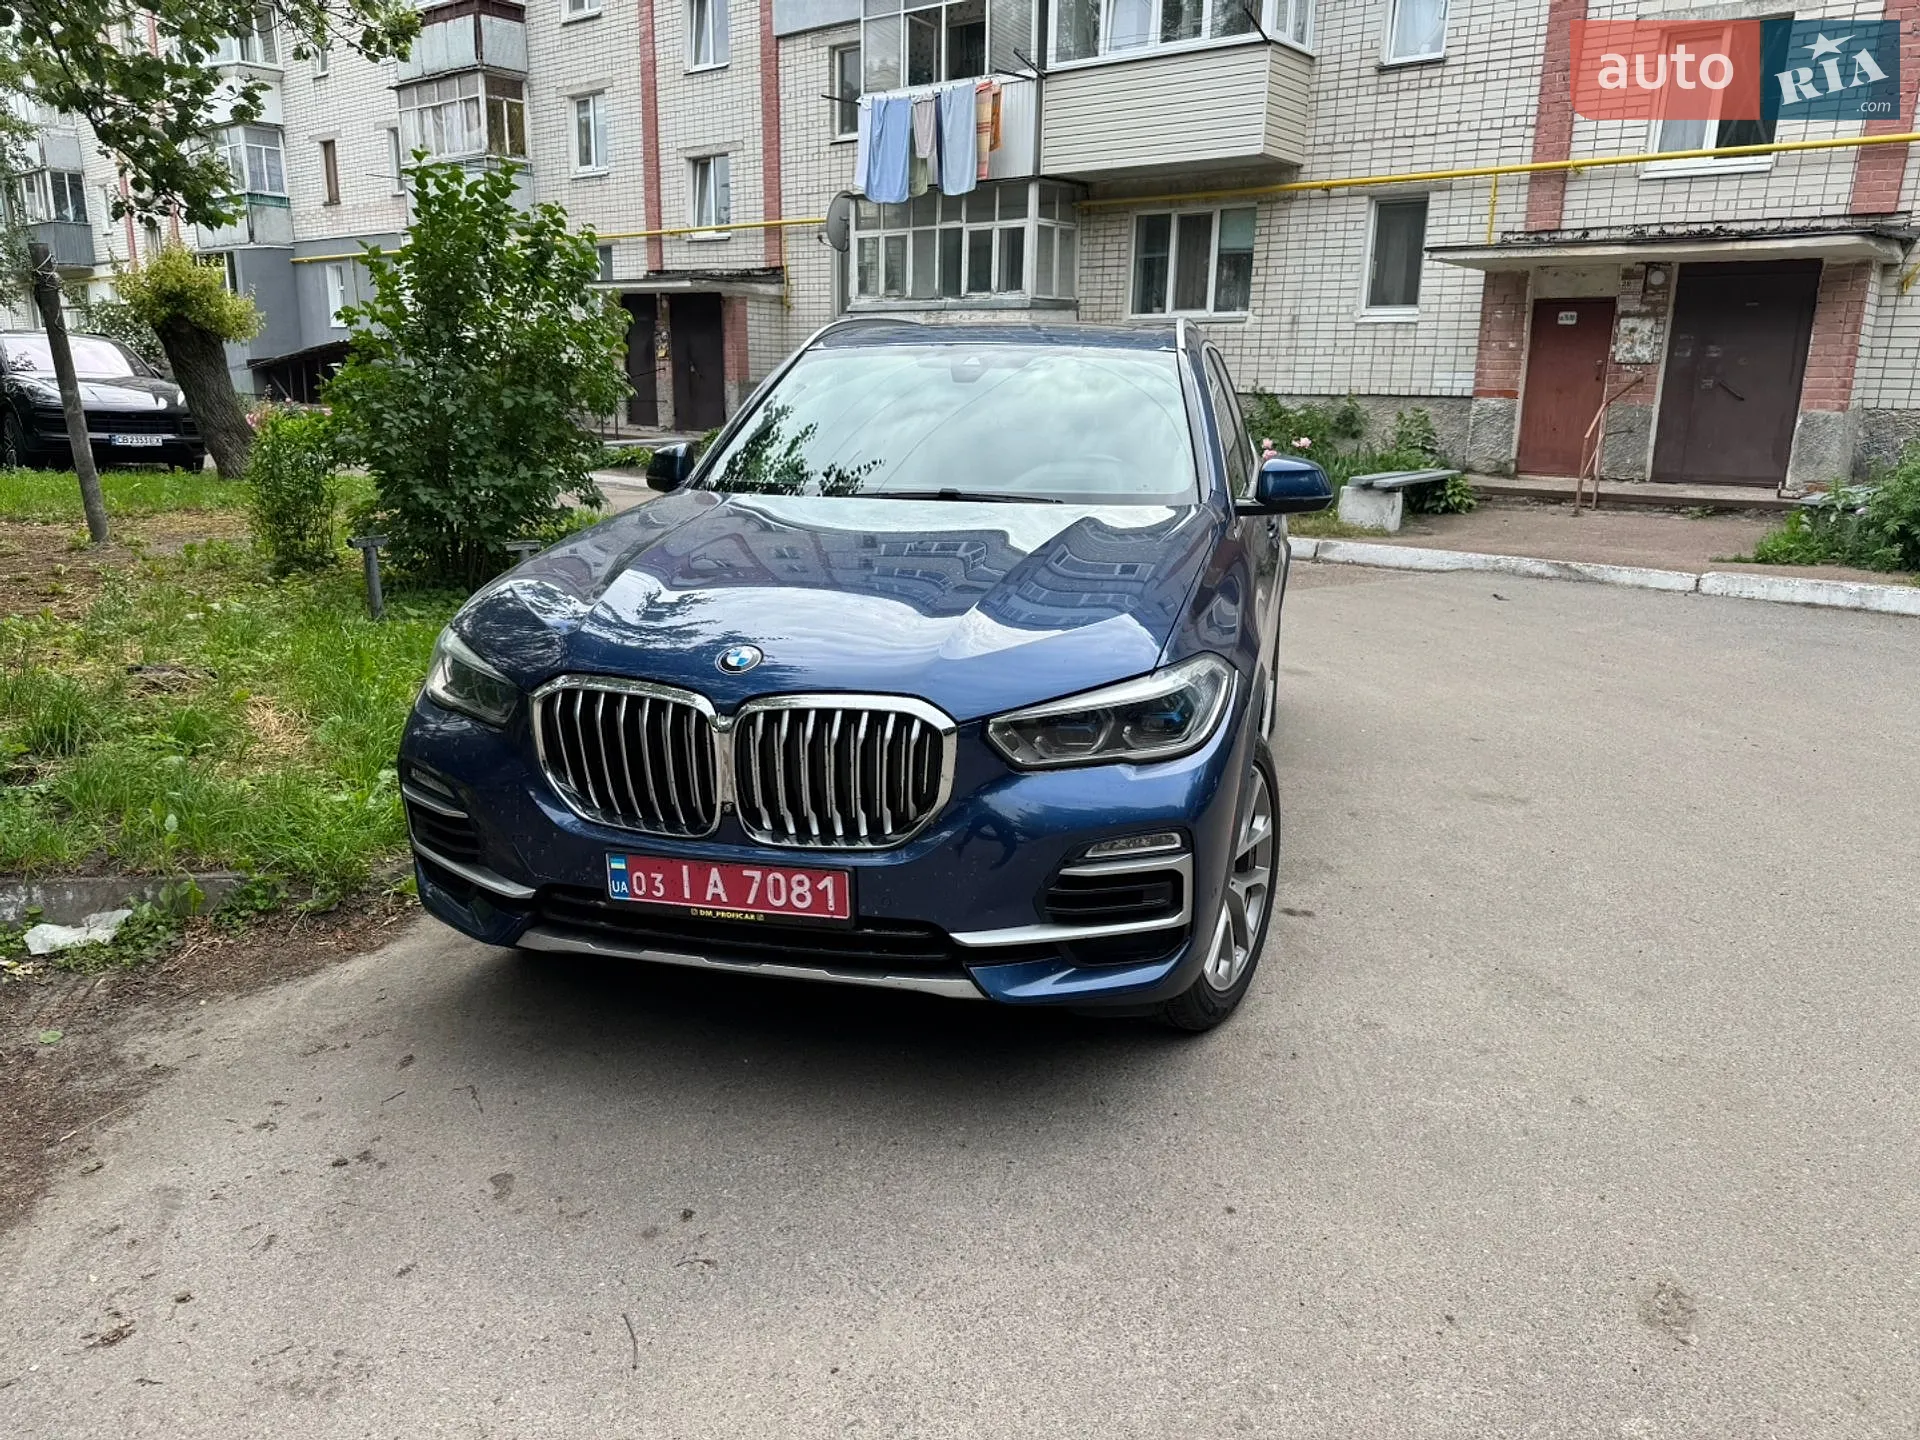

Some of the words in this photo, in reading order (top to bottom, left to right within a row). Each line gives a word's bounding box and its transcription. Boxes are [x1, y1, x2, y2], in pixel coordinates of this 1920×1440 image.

[611, 880, 629, 894] UA
[632, 871, 665, 897] 03
[742, 870, 835, 911] 7081
